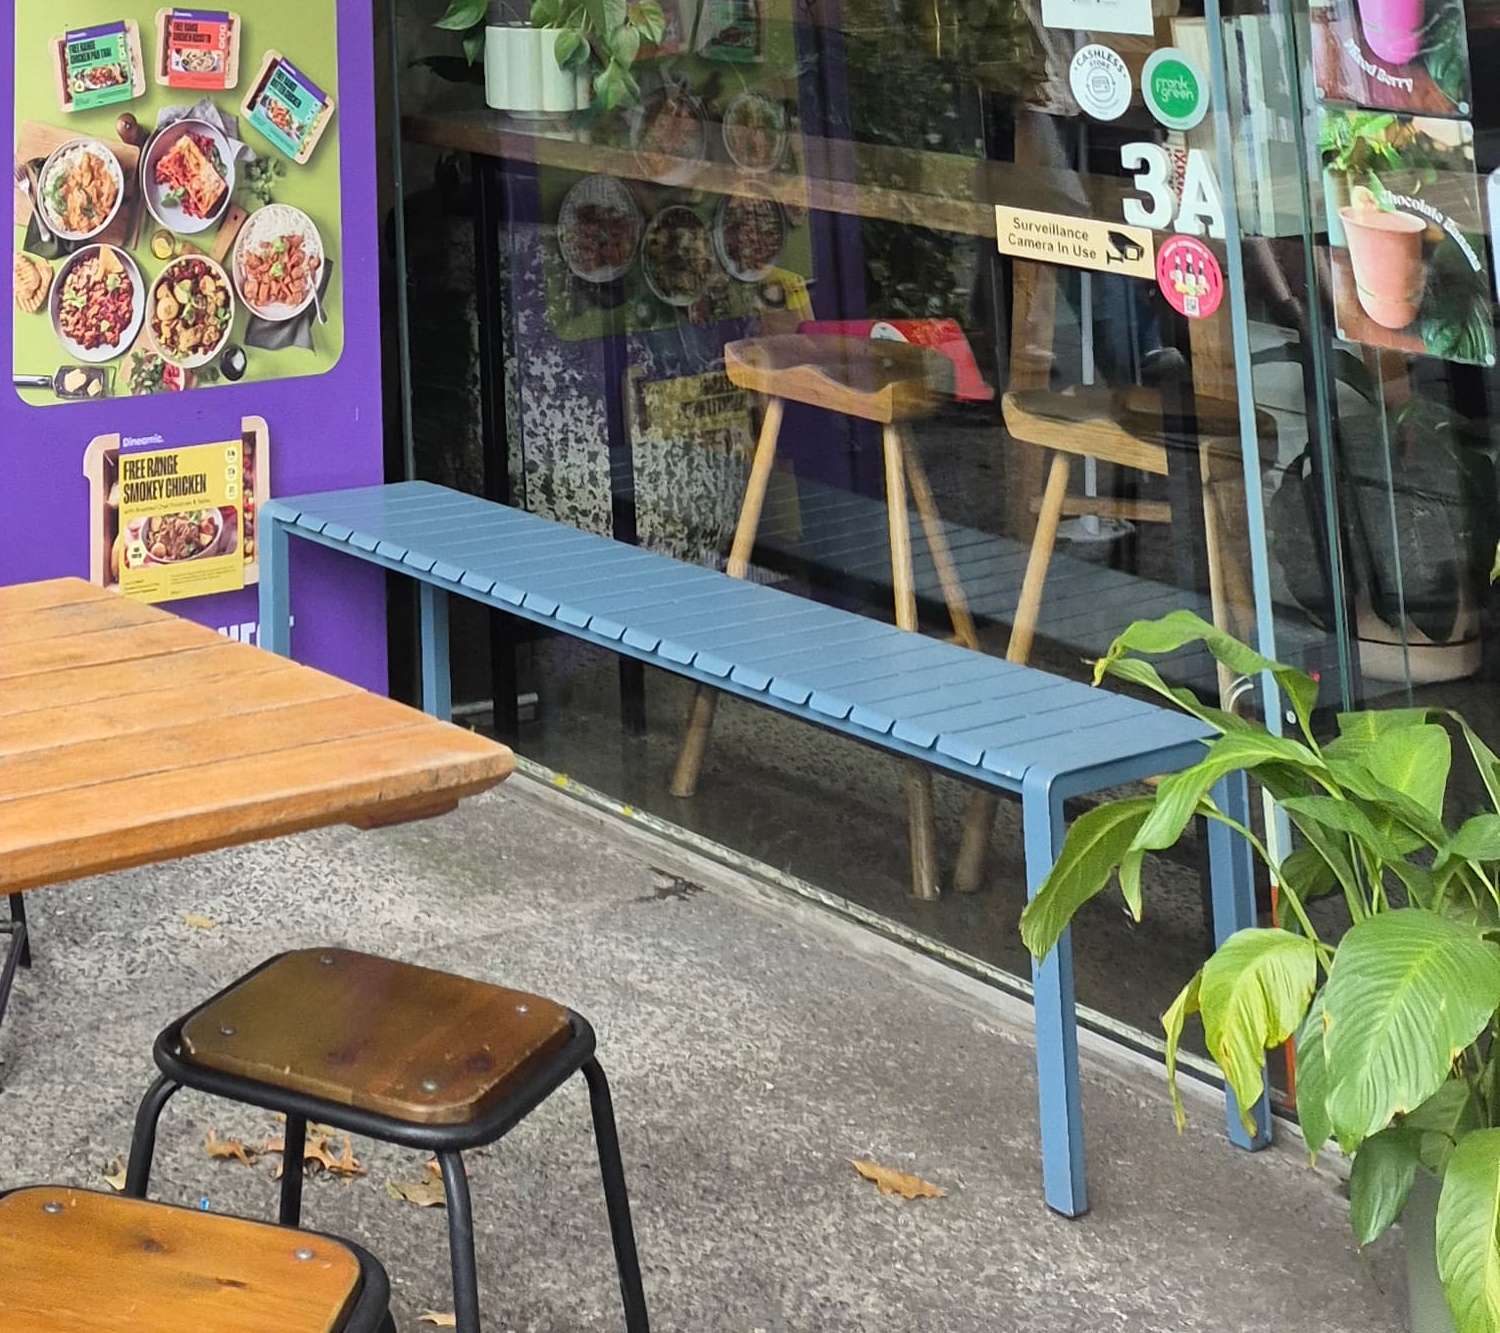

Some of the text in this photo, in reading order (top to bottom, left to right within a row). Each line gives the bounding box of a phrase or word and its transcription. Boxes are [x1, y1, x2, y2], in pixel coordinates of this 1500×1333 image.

[1076, 50, 1125, 74] CASHLESS
[1089, 59, 1111, 70] STORE
[1155, 75, 1189, 94] frank
[1161, 88, 1195, 103] green
[1120, 141, 1228, 239] 3A
[1013, 217, 1090, 242] Surveillance
[1008, 233, 1097, 260] Camera In Use
[123, 454, 179, 482] FREE RANGE
[123, 473, 207, 505] SMOKEY CHICKEN
